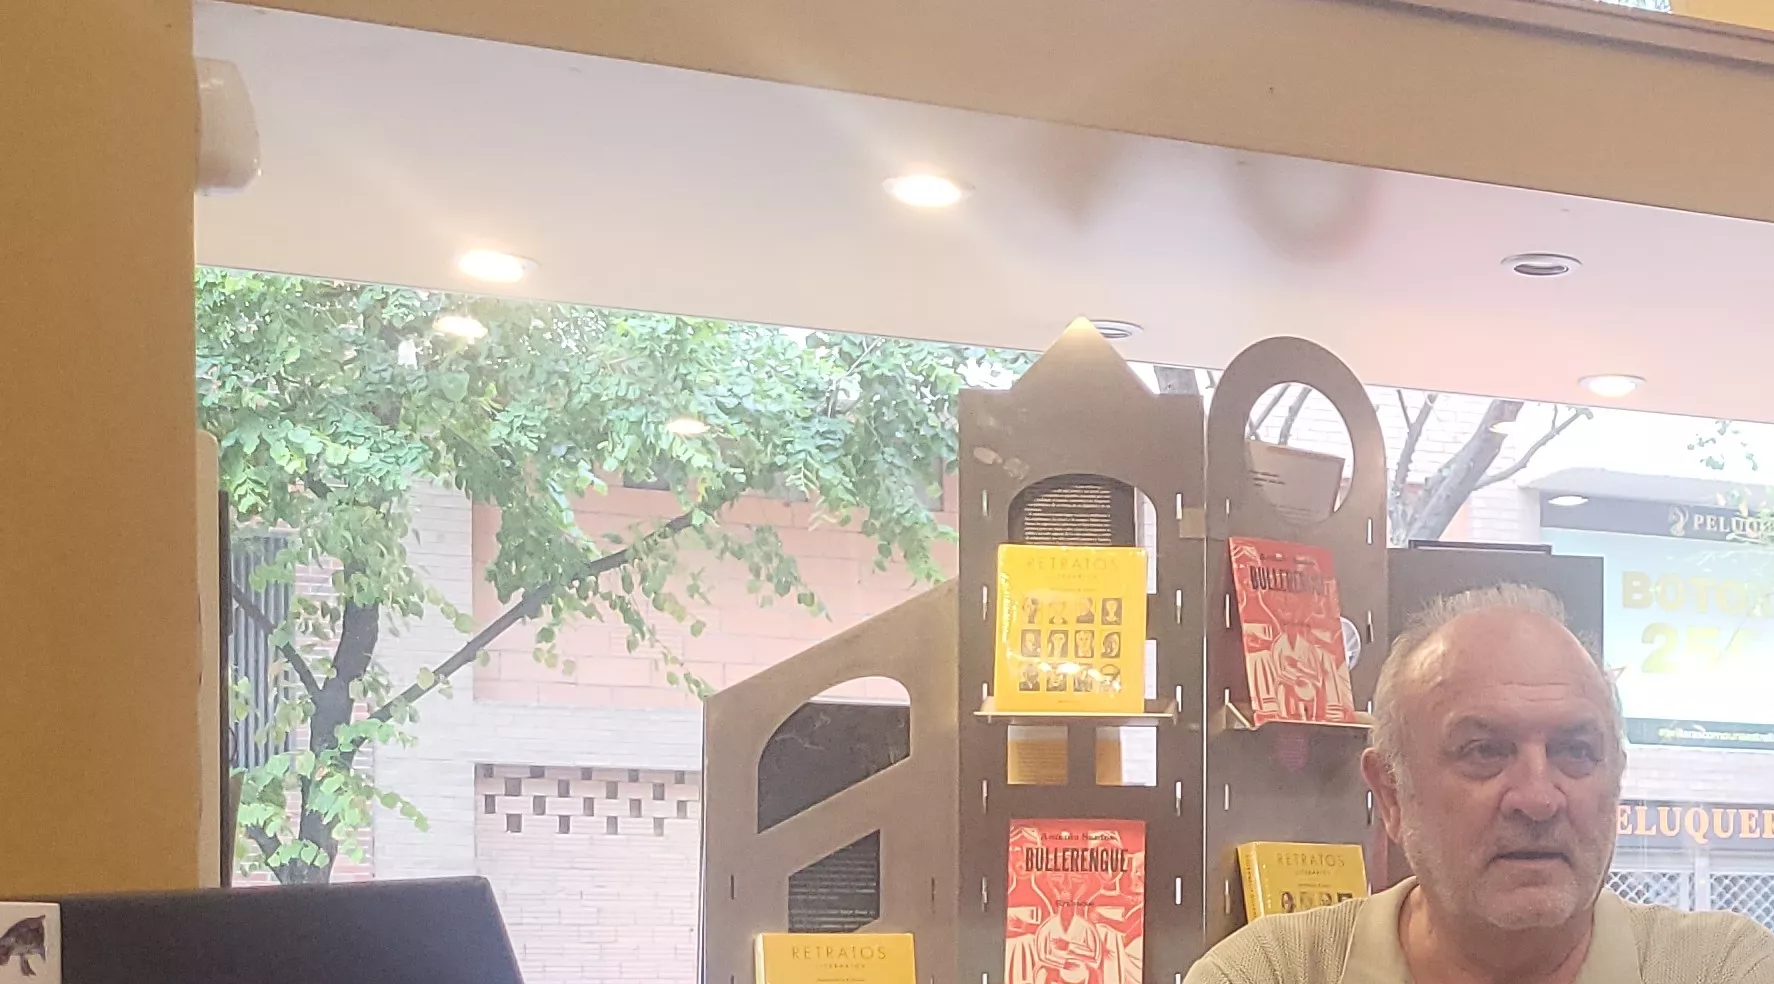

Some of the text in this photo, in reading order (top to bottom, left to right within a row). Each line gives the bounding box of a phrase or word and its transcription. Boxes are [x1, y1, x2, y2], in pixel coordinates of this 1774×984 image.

[1025, 847, 1129, 872] BULLERENGUE
[1276, 852, 1345, 868] RETRATOS
[791, 946, 887, 960] RETRATOS
